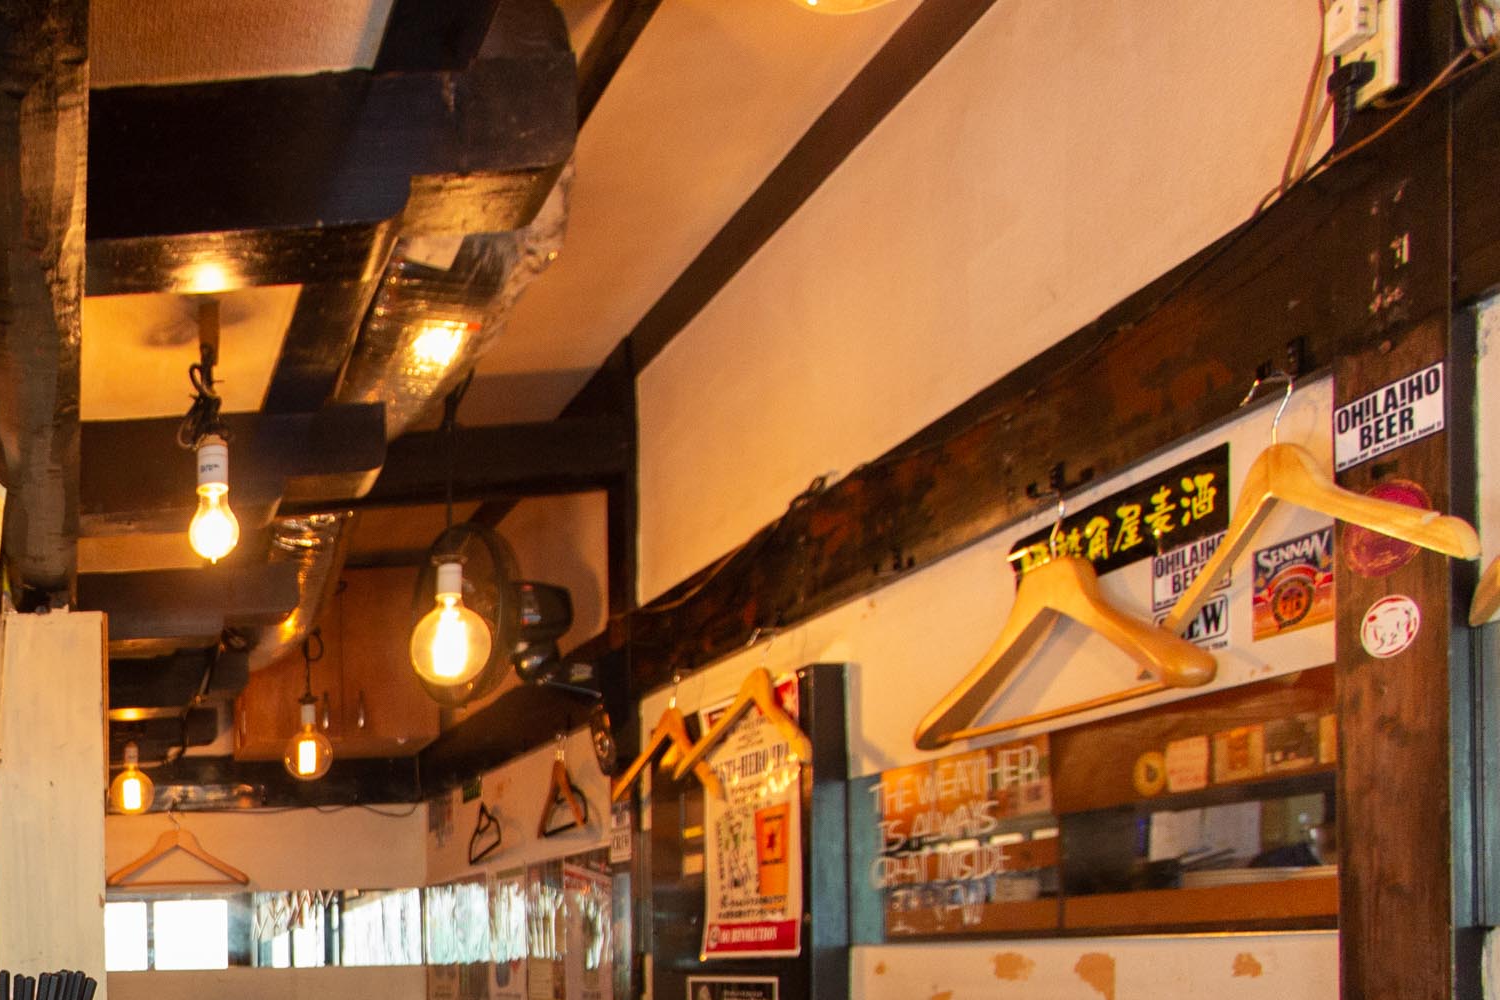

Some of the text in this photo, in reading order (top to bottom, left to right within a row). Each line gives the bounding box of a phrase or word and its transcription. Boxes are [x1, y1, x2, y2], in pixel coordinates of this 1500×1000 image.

[1336, 367, 1441, 435] OH!LA!HO
[1359, 406, 1414, 451] BEER
[1172, 564, 1204, 595] BEE
[869, 745, 1041, 817] THE WEATHER
[878, 799, 999, 852] IS ALWAYS
[938, 843, 1012, 883] INSIDE
